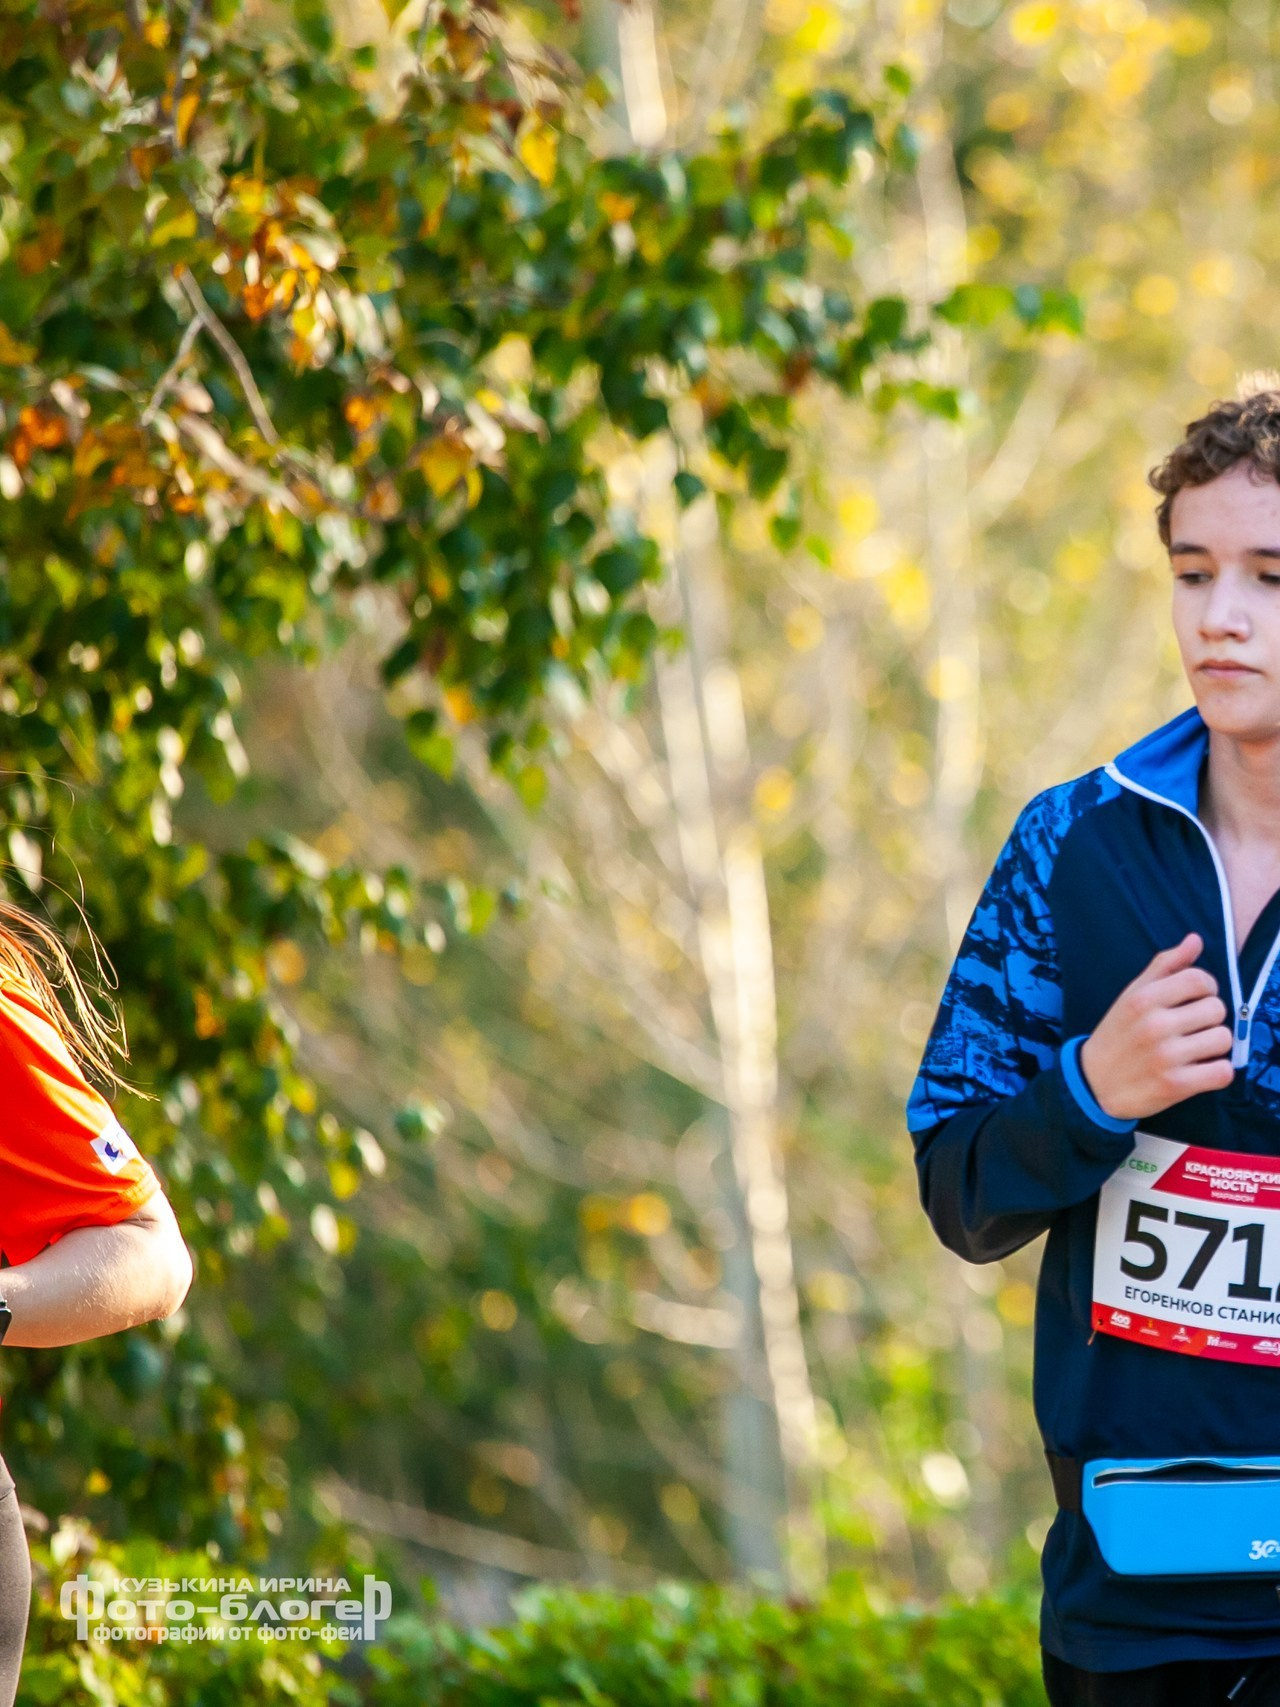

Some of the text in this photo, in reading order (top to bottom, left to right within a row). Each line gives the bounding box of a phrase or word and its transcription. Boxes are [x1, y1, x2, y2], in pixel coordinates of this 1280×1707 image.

[1128, 1158, 1158, 1174] СБЕР
[1209, 1177, 1259, 1194] МОСТЫ
[1210, 1190, 1256, 1203] МАРАФОН
[1124, 1285, 1214, 1318] ЕГОРЕНКОВ
